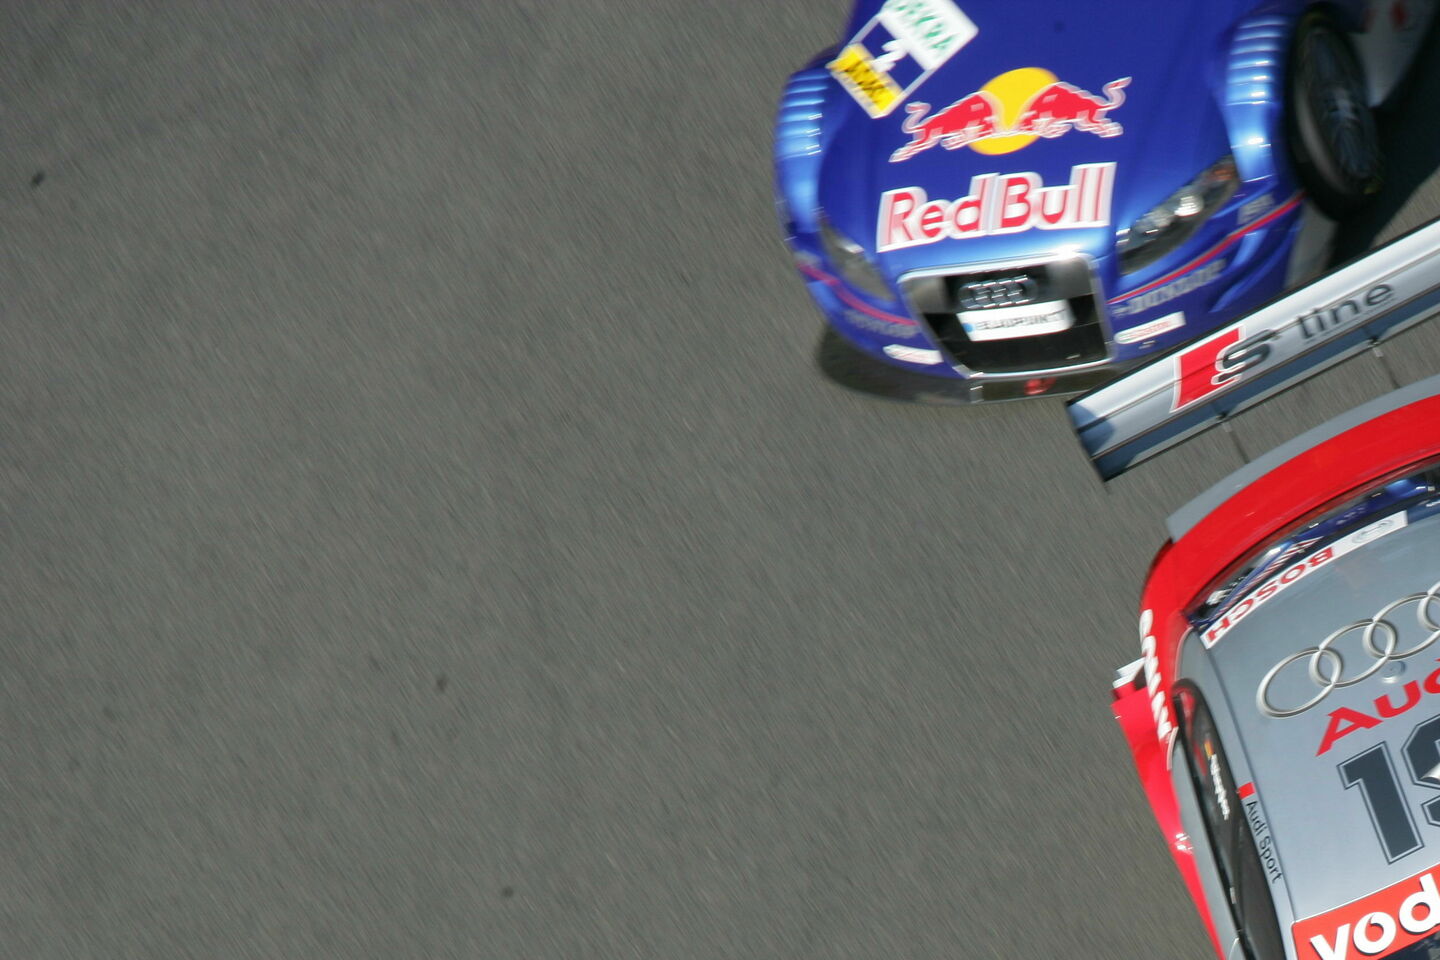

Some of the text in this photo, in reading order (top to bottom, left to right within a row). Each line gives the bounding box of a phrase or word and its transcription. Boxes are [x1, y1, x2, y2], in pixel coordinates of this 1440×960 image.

[879, 163, 1114, 251] Red Bull
[1297, 284, 1393, 339] line
[1207, 547, 1334, 642] BOSCH
[1246, 800, 1283, 884] Audi Sport
